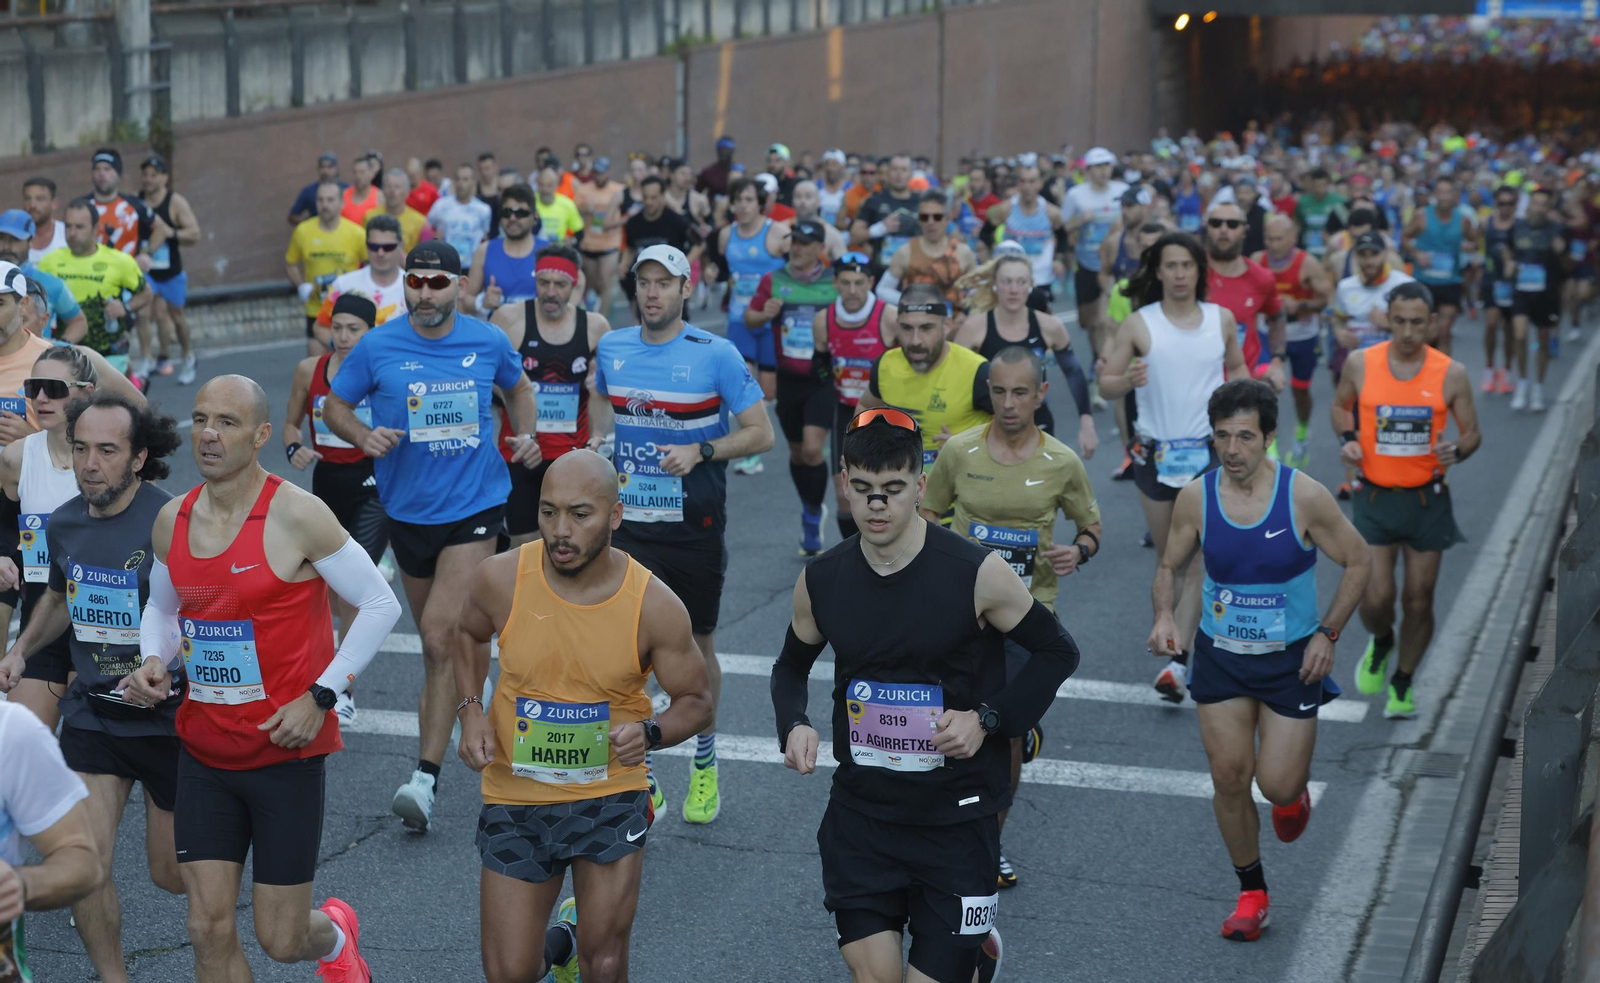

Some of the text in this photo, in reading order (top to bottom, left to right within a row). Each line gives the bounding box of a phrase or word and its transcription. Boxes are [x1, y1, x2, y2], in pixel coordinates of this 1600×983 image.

[431, 382, 468, 392] ZURICH
[543, 385, 574, 393] ZURICH
[433, 401, 453, 410] 6727
[425, 412, 463, 425] DENIS
[537, 410, 565, 420] DAVID
[637, 418, 684, 429] TRIATHLON
[429, 440, 468, 452] SEVILLA
[638, 465, 669, 474] ZURIC
[639, 483, 657, 491] 5244
[618, 492, 681, 508] GUILLAUME
[992, 530, 1031, 543] ZURICH
[86, 571, 127, 585] ZURICH
[88, 593, 109, 605] 4861
[1235, 596, 1276, 606] ZURICH
[72, 605, 132, 627] ALBERTO
[1236, 615, 1257, 624] 6874
[198, 626, 243, 637] ZURICH
[1228, 625, 1267, 640] PIOSA
[202, 650, 225, 662] 7235
[195, 664, 241, 684] PEDRO
[877, 688, 931, 701] ZURICH
[547, 707, 598, 719] ZURICH
[879, 714, 907, 727] 8319
[547, 732, 576, 743] 2017
[851, 730, 938, 752] O. AGIRRETXE
[531, 746, 590, 765] HARRY
